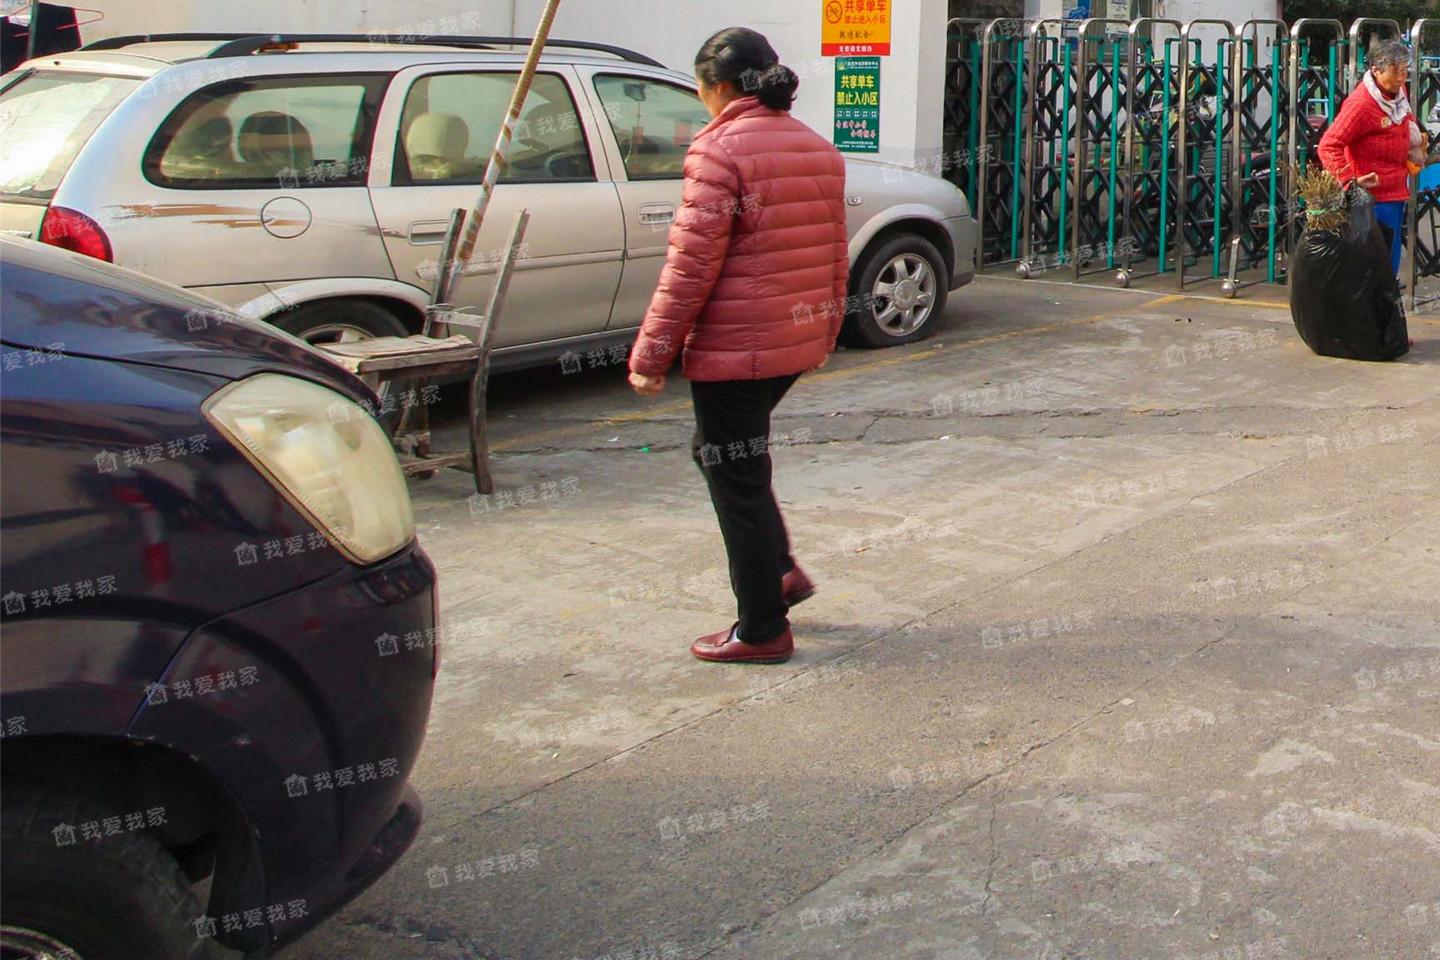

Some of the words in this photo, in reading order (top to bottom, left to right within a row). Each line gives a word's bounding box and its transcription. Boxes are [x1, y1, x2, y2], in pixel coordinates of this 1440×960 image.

[845, 0, 887, 13] 共享单车
[841, 75, 875, 89] 共享单车
[836, 91, 879, 106] 禁止入小区
